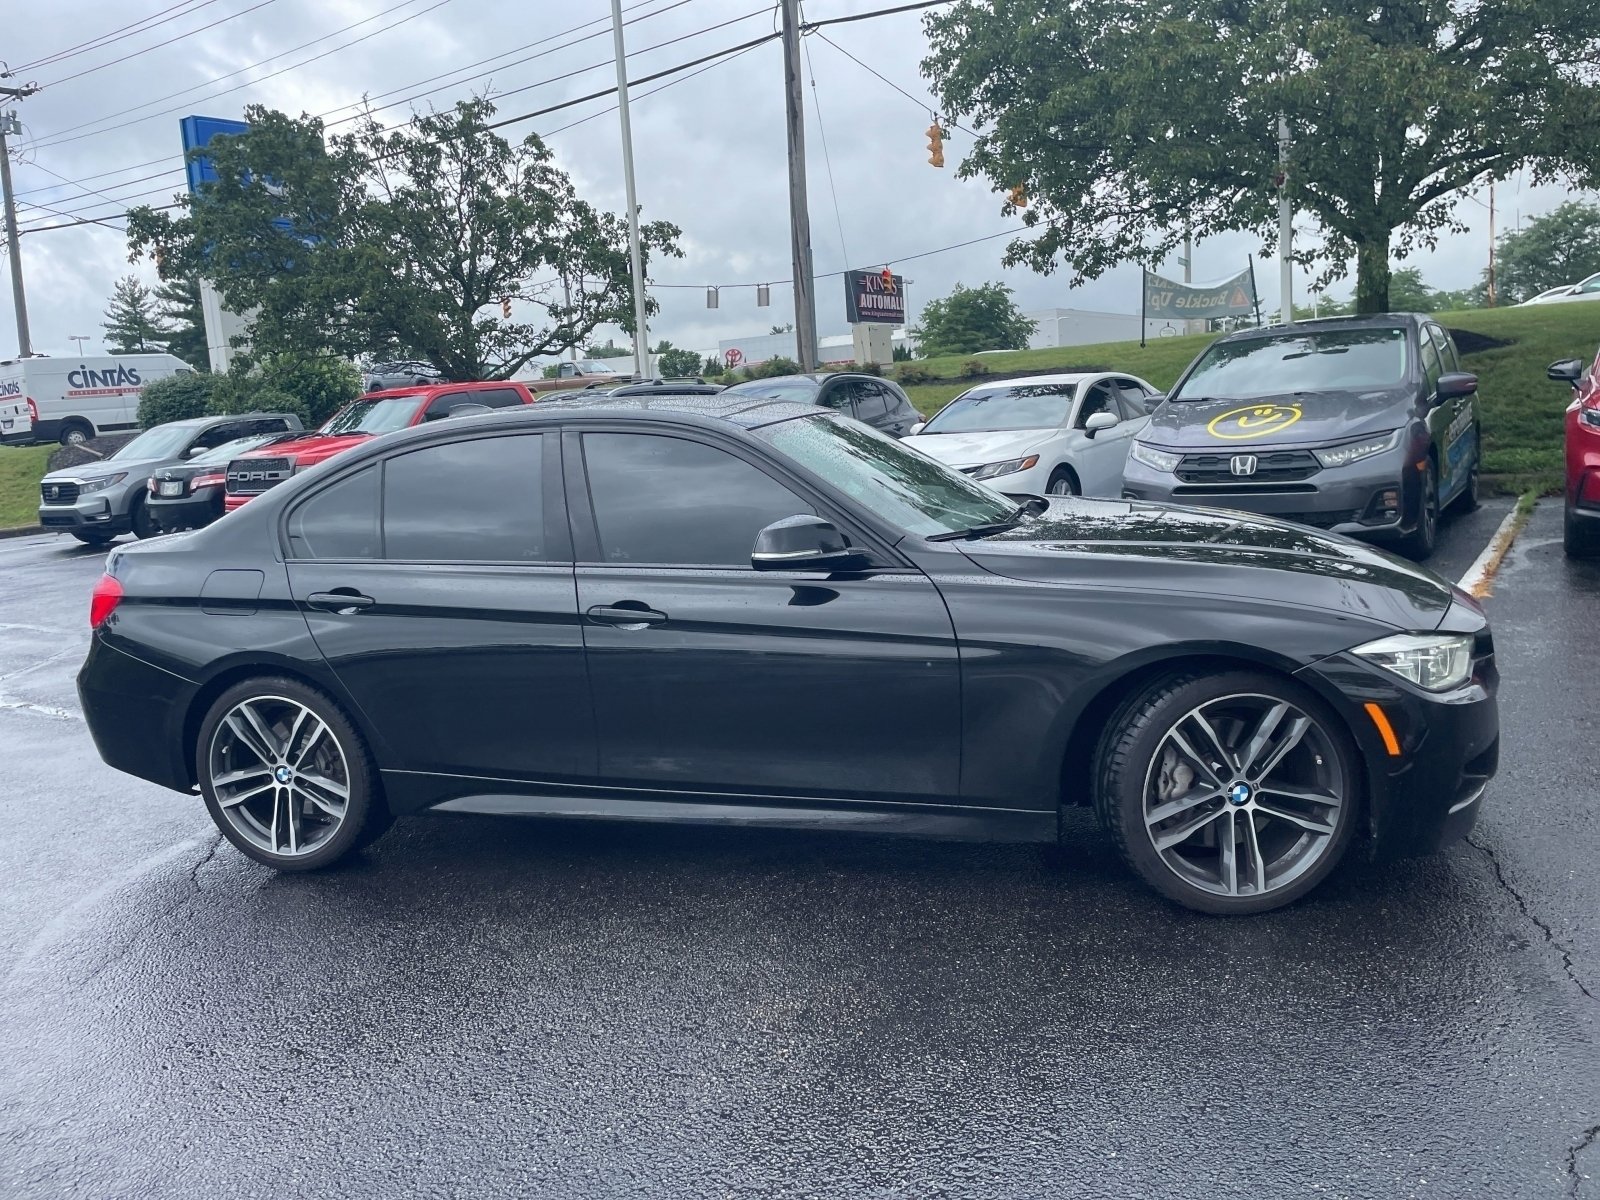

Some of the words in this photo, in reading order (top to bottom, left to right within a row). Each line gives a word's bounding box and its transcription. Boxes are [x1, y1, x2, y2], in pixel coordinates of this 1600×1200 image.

[866, 275, 897, 294] KINS
[859, 293, 904, 310] AUTOMALL
[67, 362, 142, 389] CINTAS
[227, 470, 281, 481] FORD
